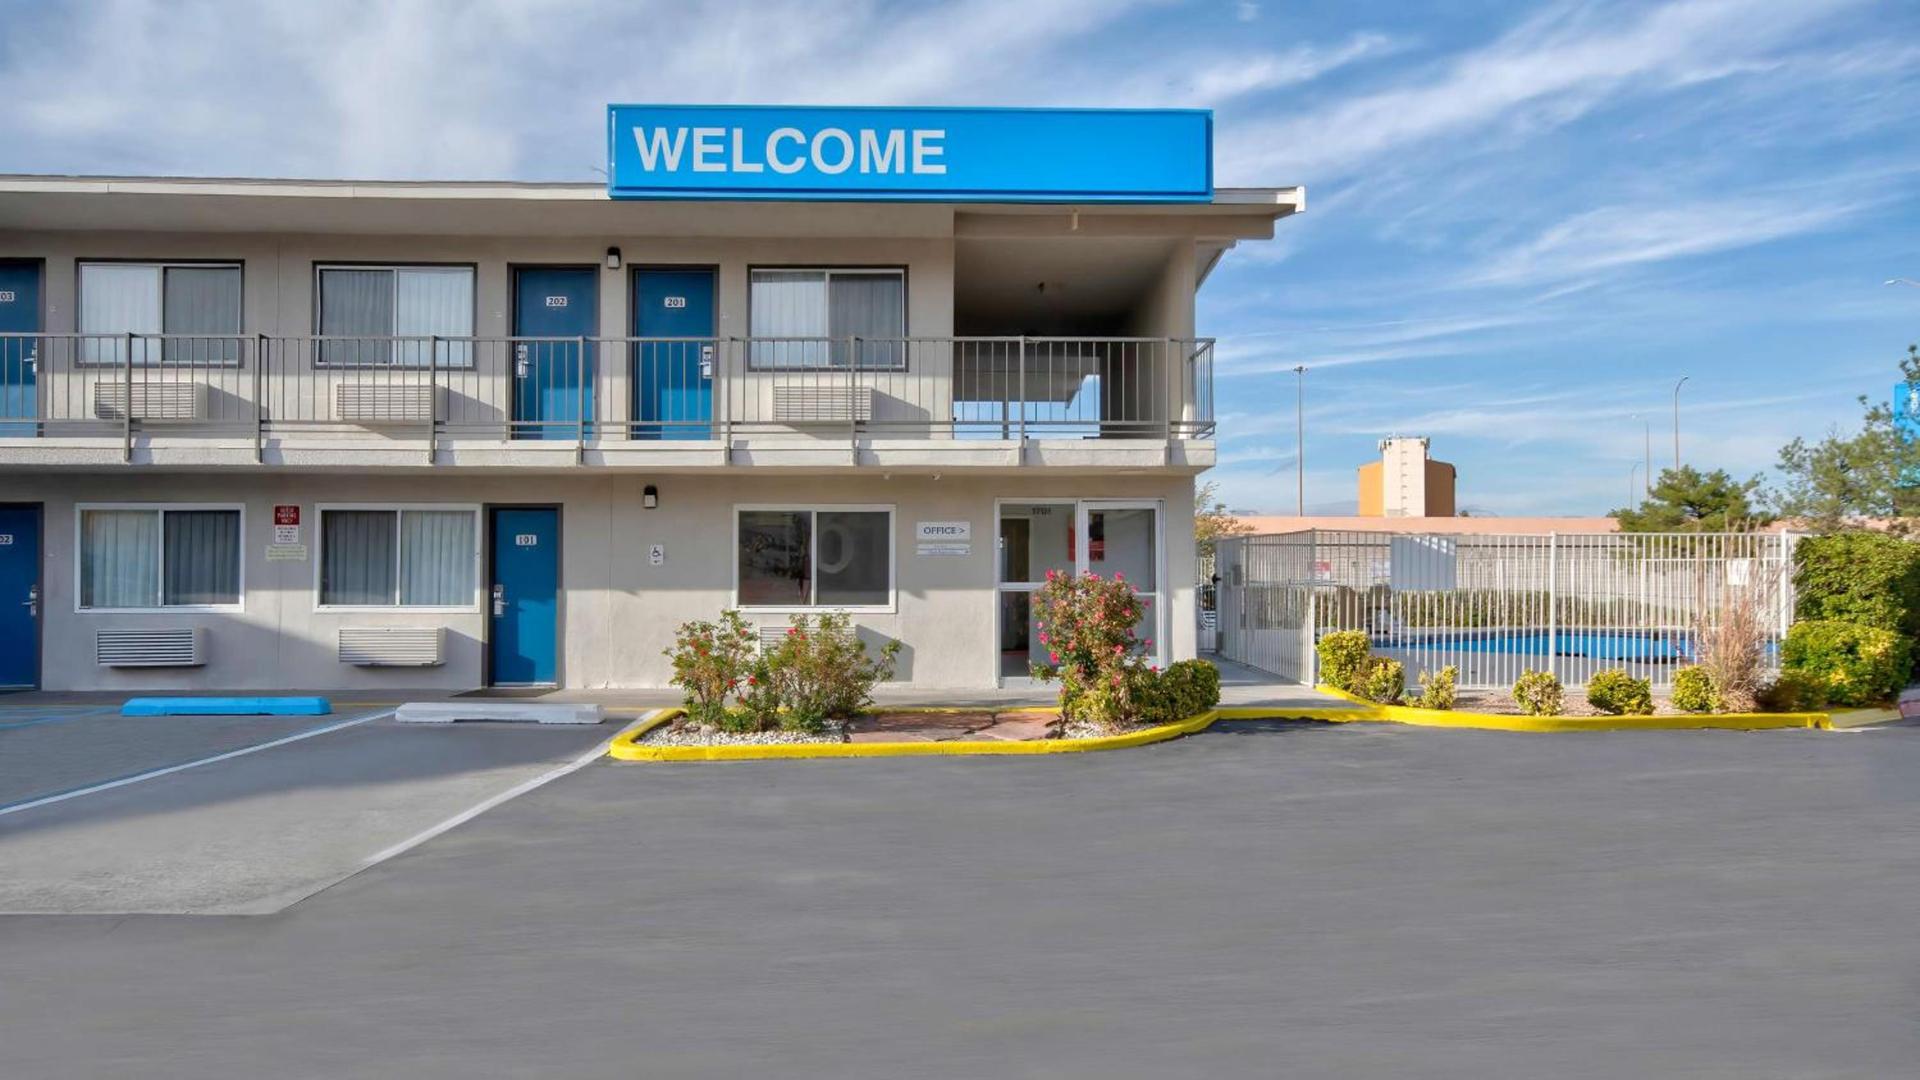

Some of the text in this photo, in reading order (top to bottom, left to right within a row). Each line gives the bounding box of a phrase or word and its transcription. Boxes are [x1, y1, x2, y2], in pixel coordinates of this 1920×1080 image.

[632, 126, 947, 175] WELCOME
[548, 297, 565, 305] 202
[667, 298, 684, 306] 201
[923, 526, 956, 535] OFFICE
[519, 535, 534, 545] 101
